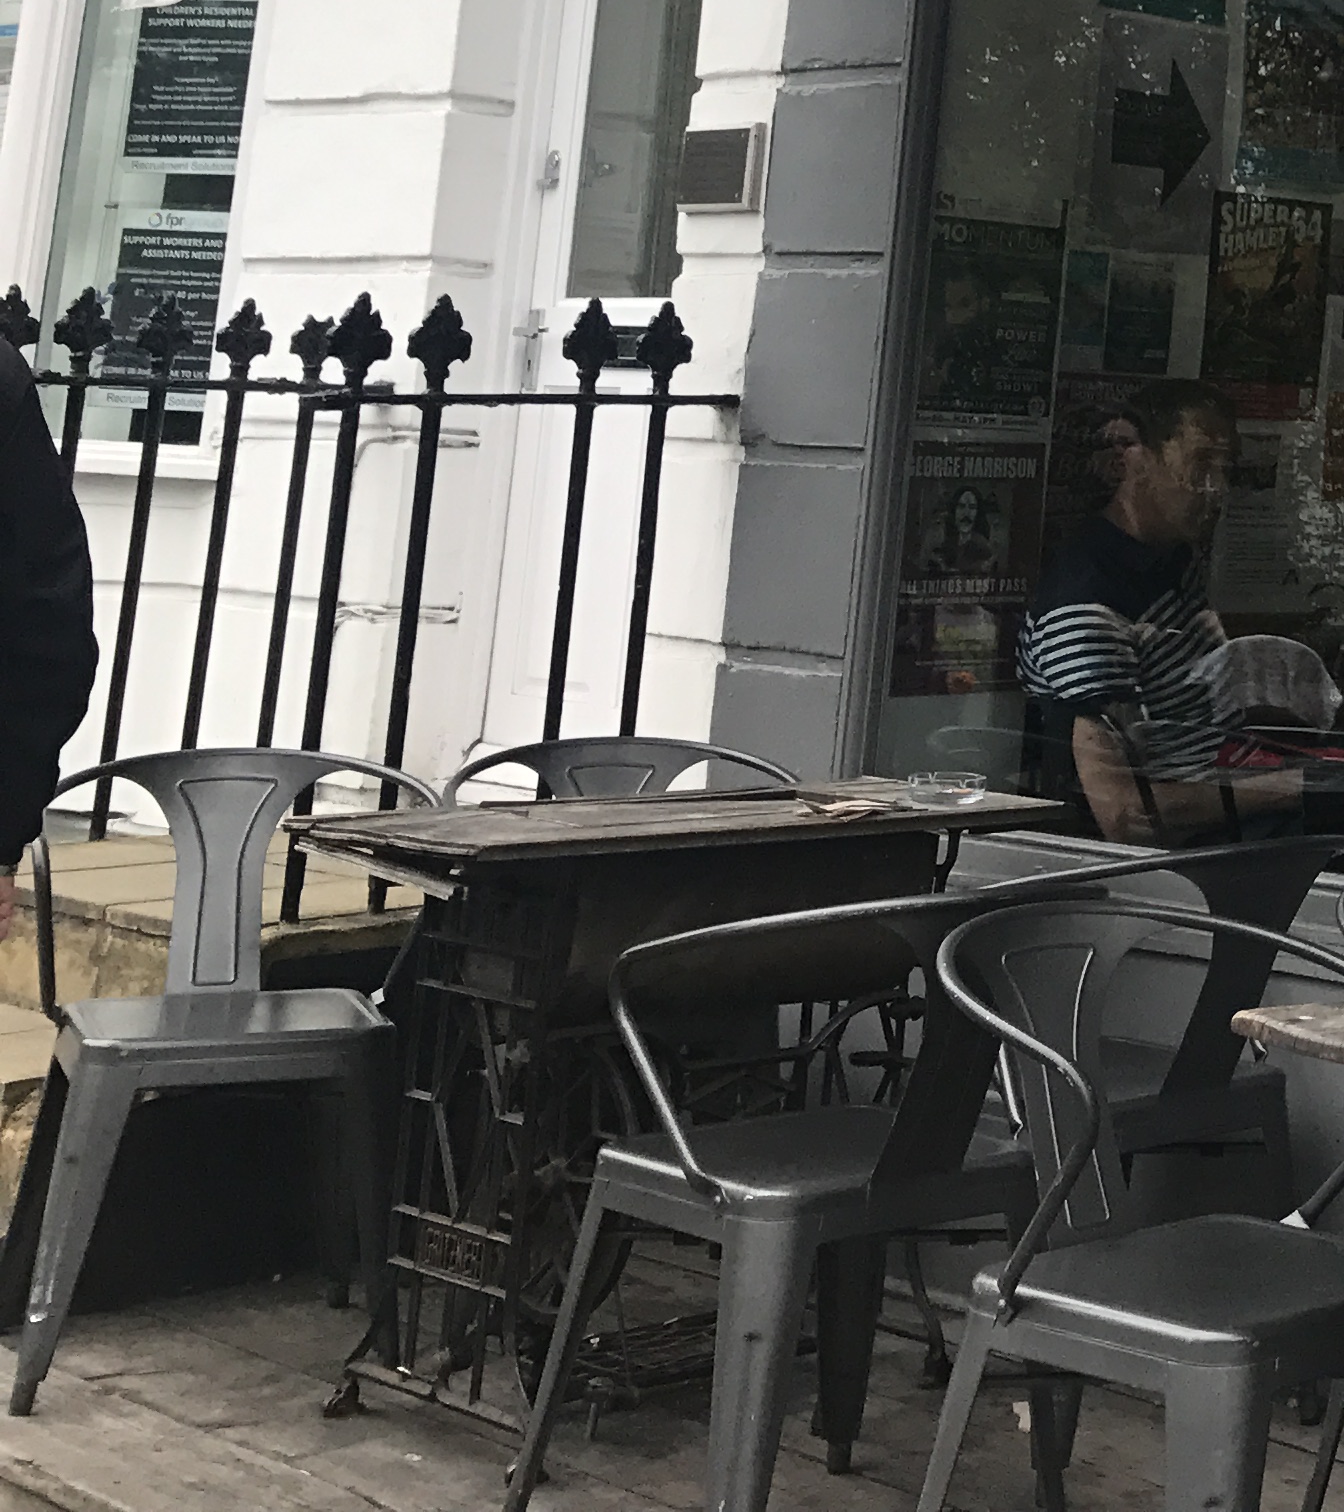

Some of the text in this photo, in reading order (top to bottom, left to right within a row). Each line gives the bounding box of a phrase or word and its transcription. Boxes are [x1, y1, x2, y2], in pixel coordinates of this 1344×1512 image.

[1220, 200, 1291, 234] SUPER
[1291, 206, 1325, 247] 64
[123, 235, 224, 249] SUPPORT WORKERS AND
[1218, 225, 1289, 257] HAMLET
[963, 456, 1038, 480] HARRISON
[999, 577, 1028, 595] PASS
